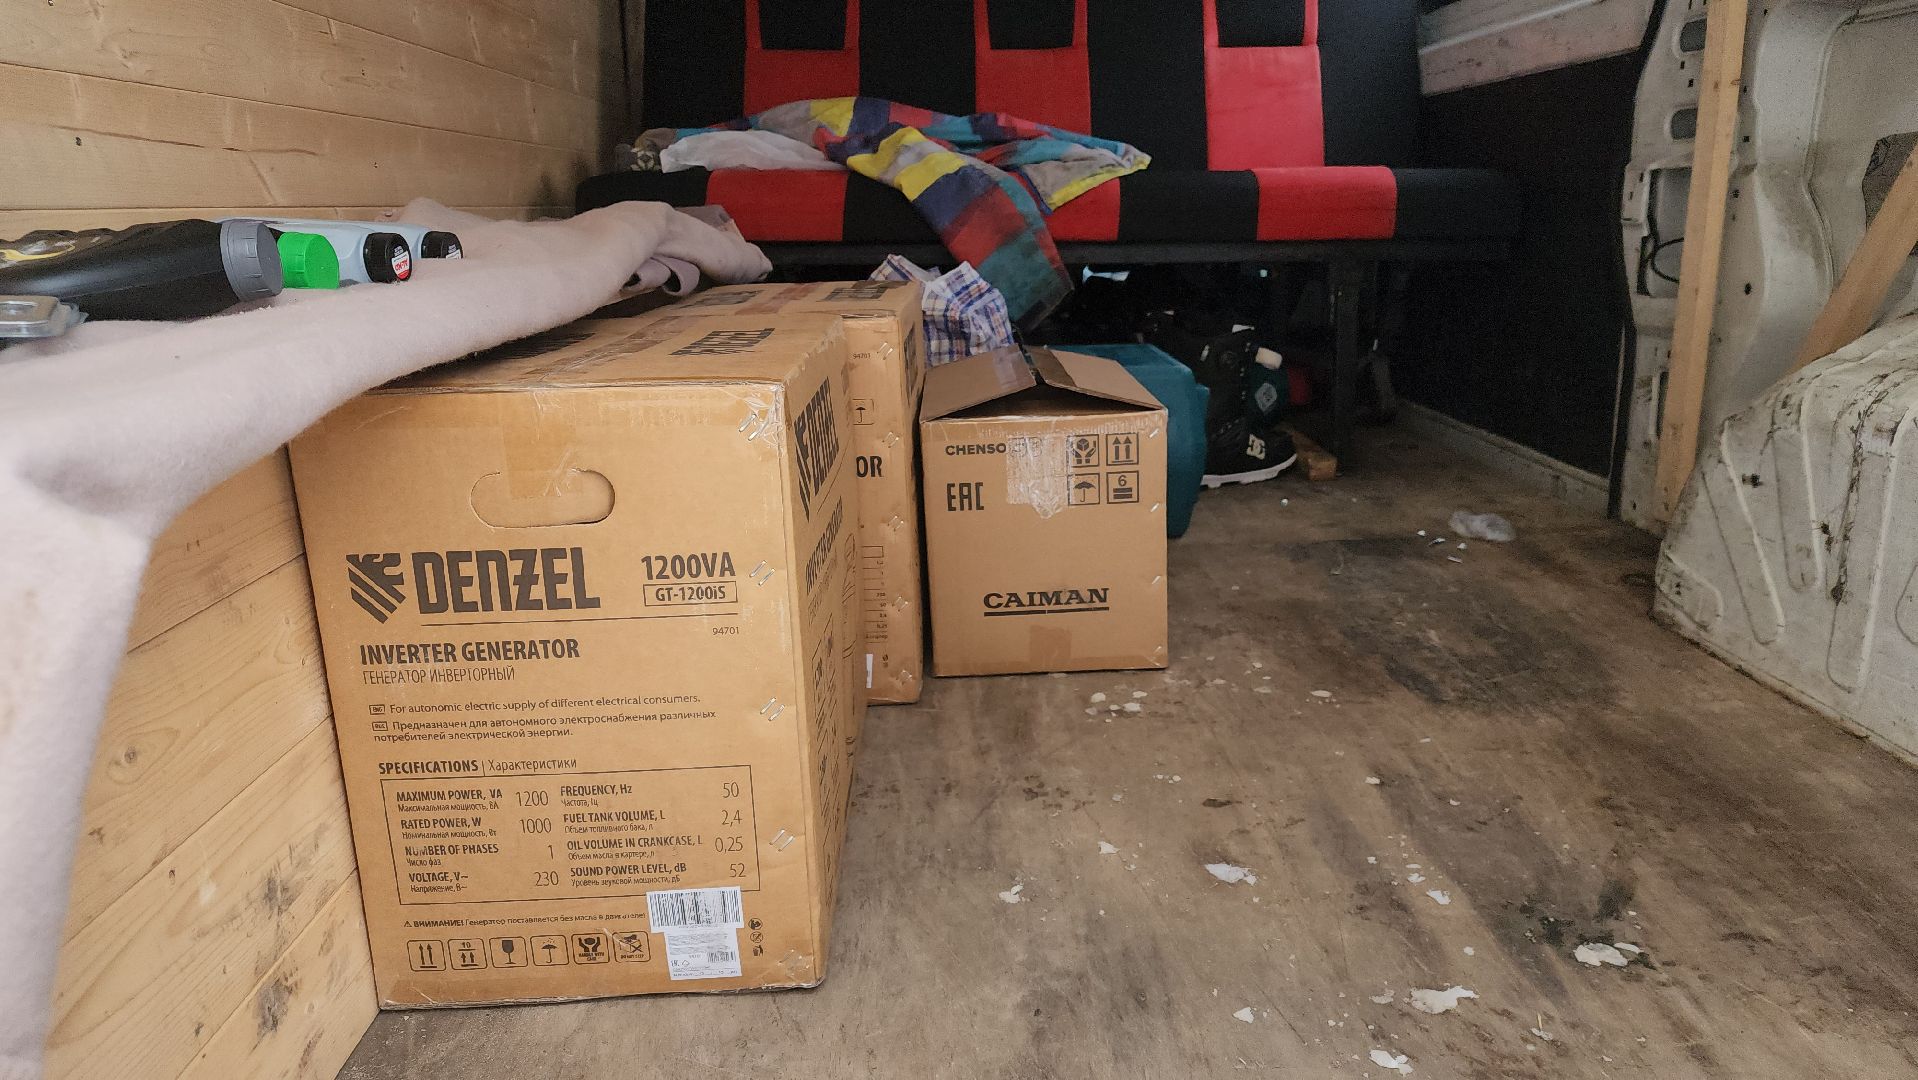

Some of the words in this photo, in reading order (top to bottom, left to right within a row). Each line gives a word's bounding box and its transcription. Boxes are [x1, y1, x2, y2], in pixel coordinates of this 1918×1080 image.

[1118, 474, 1127, 486] 6
[641, 552, 736, 580] 1200VA
[411, 546, 601, 615] DENZEL
[656, 586, 726, 602] GT-1200iS
[983, 588, 1110, 608] CAIMAN
[712, 626, 740, 635] 94701
[360, 643, 457, 665] INVERTER
[461, 638, 580, 662] GENERATOR
[363, 669, 426, 684] ГЕНЕРАТОР
[430, 665, 515, 682] ИНВЕРТОРНЫЙ
[390, 704, 406, 714] For
[408, 703, 462, 713] autonomic
[464, 702, 501, 711] electric
[502, 700, 537, 712] supply
[538, 699, 551, 708] of
[551, 698, 594, 708] different
[596, 696, 642, 706] electrical
[644, 695, 701, 704] consumers.
[392, 718, 466, 732] Предназначен
[469, 720, 488, 729] для
[490, 718, 557, 728] автономного
[559, 714, 658, 726] электроснабжения
[660, 712, 716, 722] различных
[374, 731, 446, 744] потребителей
[448, 728, 526, 741] электрической
[528, 729, 574, 738] энергии.
[378, 760, 478, 774] SPECIFICATIONS
[488, 759, 577, 772] Характеристики
[396, 790, 446, 802] MAXIMUM
[448, 790, 486, 800] POWER,
[490, 788, 502, 798] VA
[560, 784, 618, 796] FREQUENCY,
[620, 784, 632, 794] Hz
[722, 782, 740, 798] 50
[516, 790, 548, 807] 1200
[401, 818, 430, 829] RATED
[432, 818, 470, 828] POWER,
[472, 817, 482, 826] W
[564, 813, 588, 823] FUEL
[588, 812, 614, 822] TANK
[615, 810, 658, 822] VOLUME,
[660, 810, 666, 820] L
[722, 810, 742, 826] 2,4
[520, 818, 552, 834] 1000
[405, 845, 446, 856] NUMBER
[448, 844, 460, 855] OF
[463, 844, 498, 854] PHASES
[567, 840, 583, 850] OIL
[584, 838, 623, 850] VOLUME
[626, 838, 636, 848] IN
[638, 836, 696, 847] CRANKCASE,
[698, 836, 703, 844] L
[715, 836, 744, 853] 0,25
[548, 845, 554, 860] 1
[406, 858, 428, 866] Число
[428, 858, 442, 867] фаз
[570, 866, 603, 876] SOUND
[606, 865, 640, 875] POWER
[642, 864, 672, 874] LEVEL,
[674, 862, 686, 872] dB
[730, 862, 746, 878] 52
[408, 872, 452, 882] VOLTAGE,
[534, 870, 558, 886] 230
[413, 919, 464, 928] ВНИМАНИЕ!
